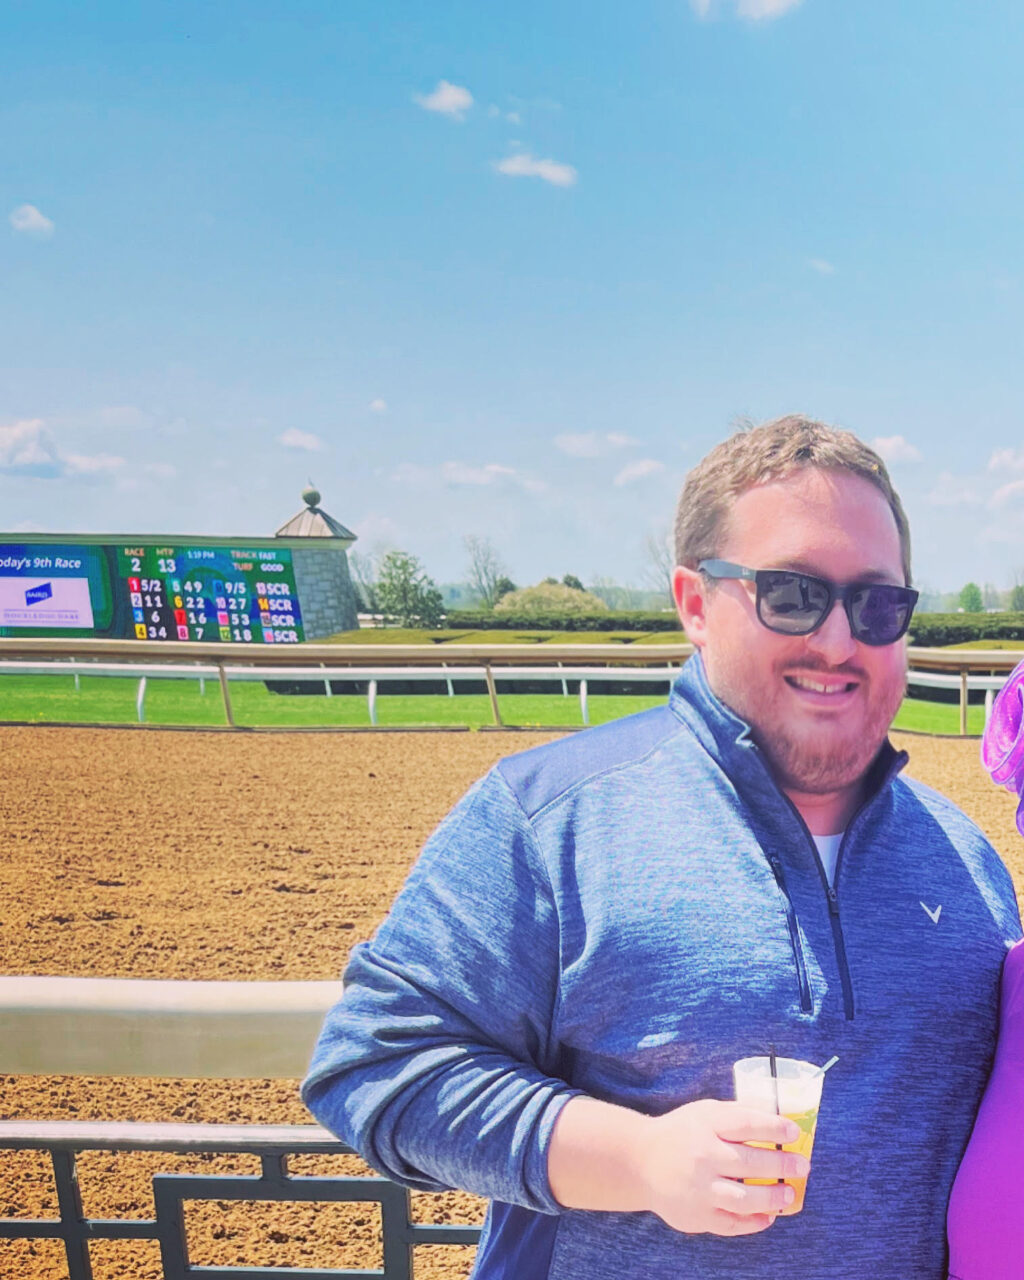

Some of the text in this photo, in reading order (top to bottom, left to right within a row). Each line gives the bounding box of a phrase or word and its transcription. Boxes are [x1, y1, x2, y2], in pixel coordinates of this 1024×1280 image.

[124, 548, 144, 556] RACE
[258, 552, 276, 560] FAST
[33, 557, 52, 568] 9th
[54, 557, 82, 568] Race
[131, 557, 141, 572] 2
[158, 558, 176, 573] 13
[141, 579, 162, 592] 5/2
[225, 582, 246, 594] 9/5
[267, 583, 290, 595] SCR
[174, 595, 183, 608] 6
[269, 599, 292, 611] SCR
[151, 610, 160, 623] 6
[272, 614, 295, 627] SCR
[195, 627, 204, 640] 7
[274, 630, 298, 643] SCR
